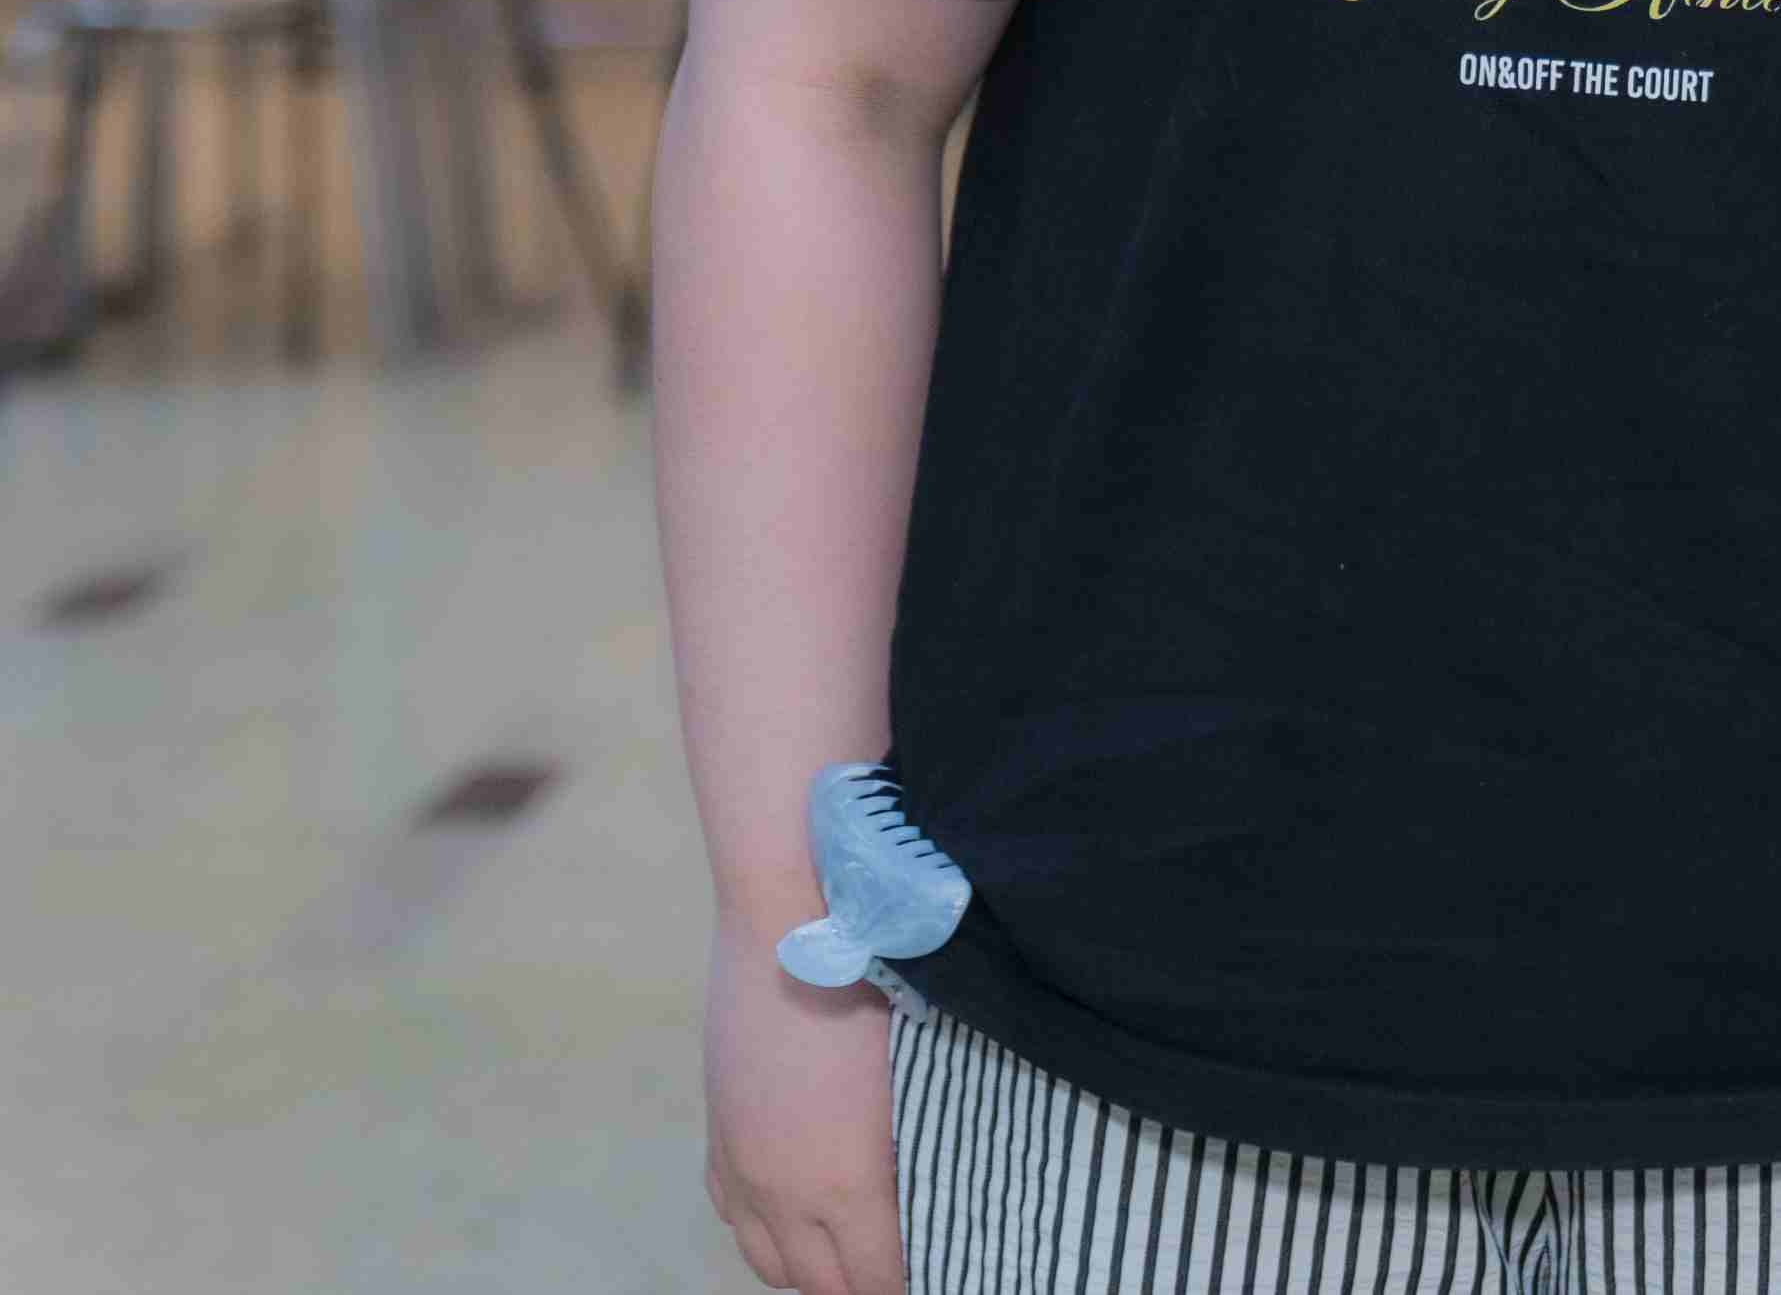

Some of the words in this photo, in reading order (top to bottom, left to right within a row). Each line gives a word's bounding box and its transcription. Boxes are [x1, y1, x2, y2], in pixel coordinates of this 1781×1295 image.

[1459, 52, 1566, 91] ON&OFF
[1569, 60, 1621, 97] THE
[1626, 65, 1715, 103] COURT
